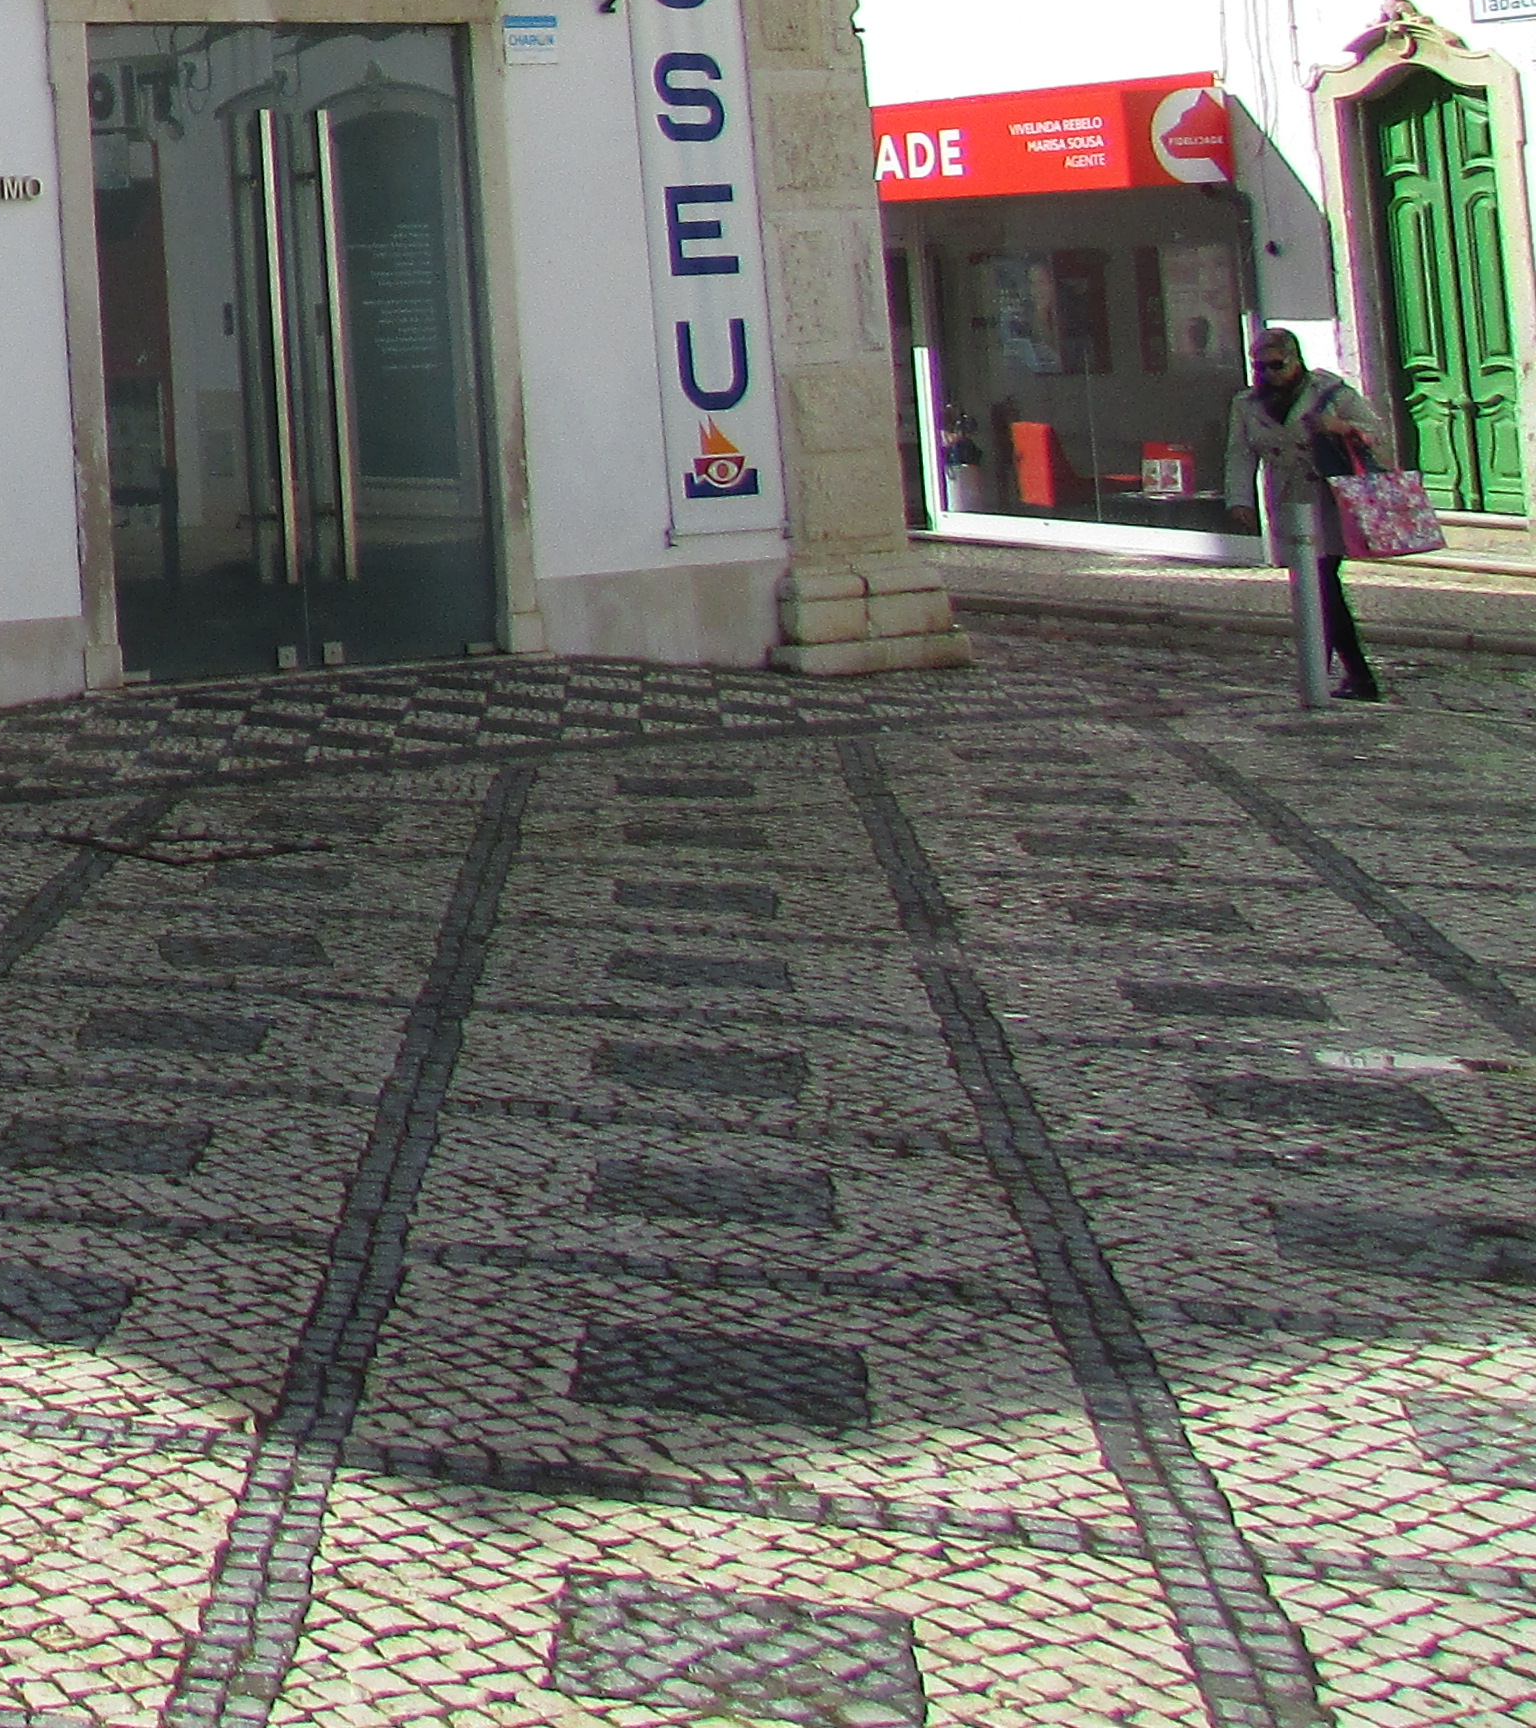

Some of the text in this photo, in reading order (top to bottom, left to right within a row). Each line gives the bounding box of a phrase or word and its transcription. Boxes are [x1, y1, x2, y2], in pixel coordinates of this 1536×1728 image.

[1008, 115, 1103, 136] VIVELINDA REBELO
[1026, 134, 1105, 153] MARISA SOUSA
[1064, 153, 1107, 168] AGENTE
